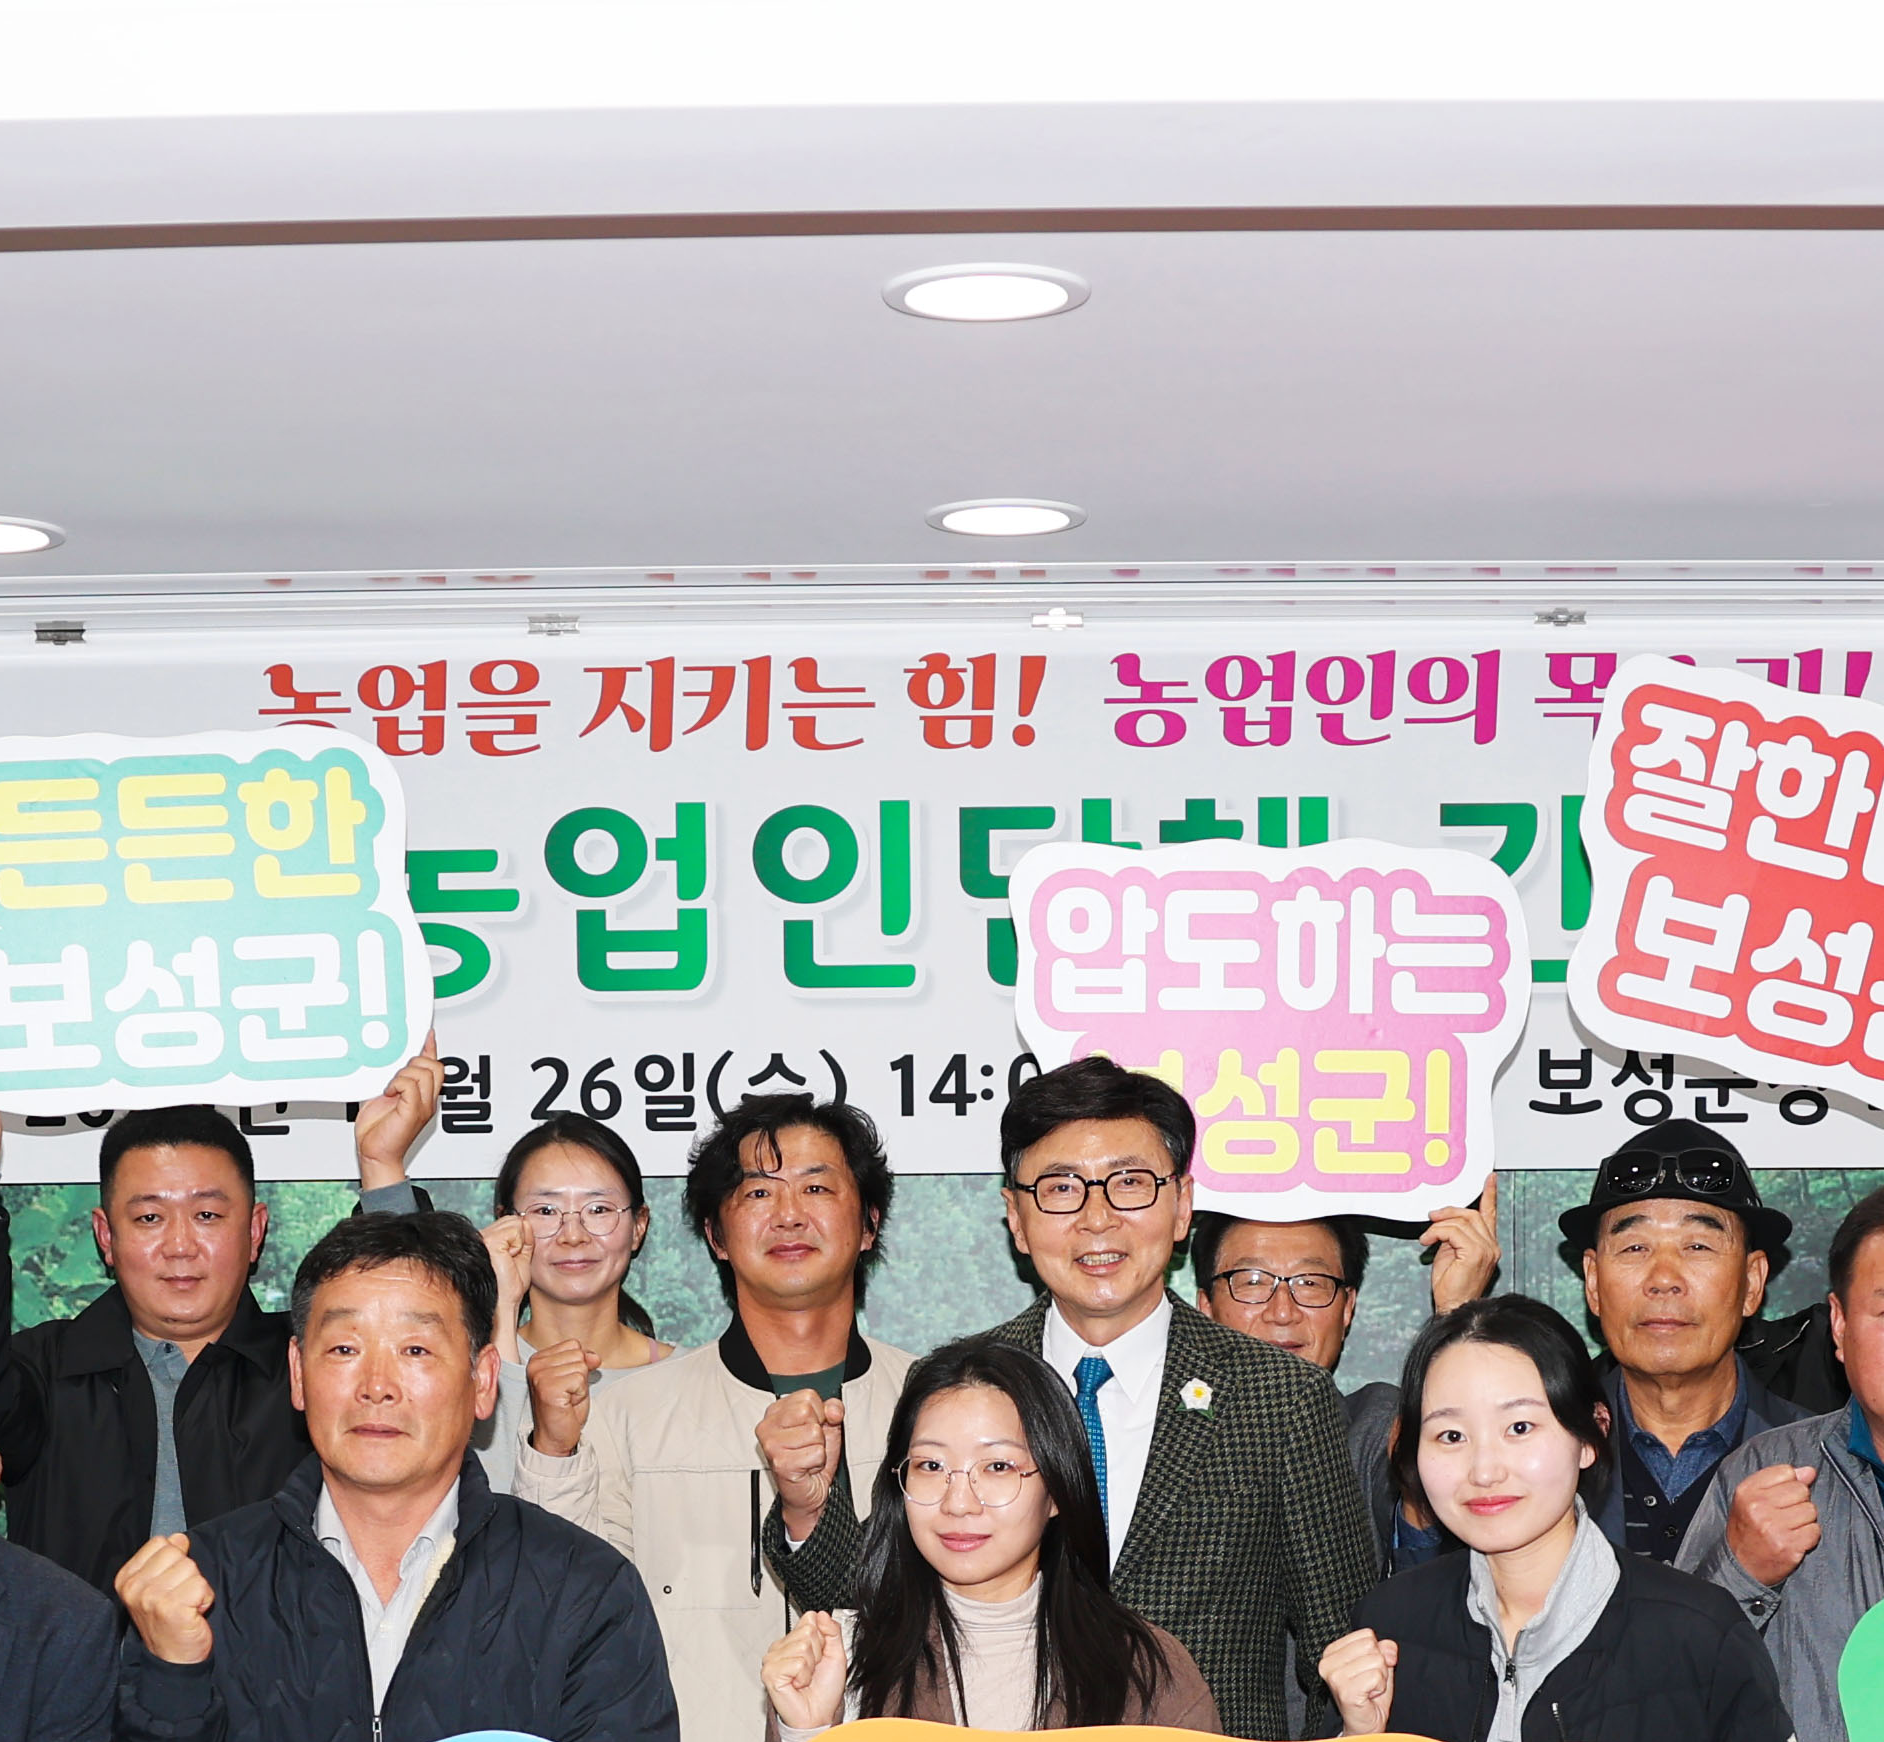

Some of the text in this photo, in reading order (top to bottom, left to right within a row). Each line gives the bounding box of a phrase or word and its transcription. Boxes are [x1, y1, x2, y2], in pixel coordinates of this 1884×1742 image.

[258, 657, 551, 758] 농업을
[578, 653, 876, 753] 지키는
[903, 651, 1048, 750] 힘!
[1104, 648, 1501, 749] 농업인의
[1046, 885, 1495, 1015] 압도하는
